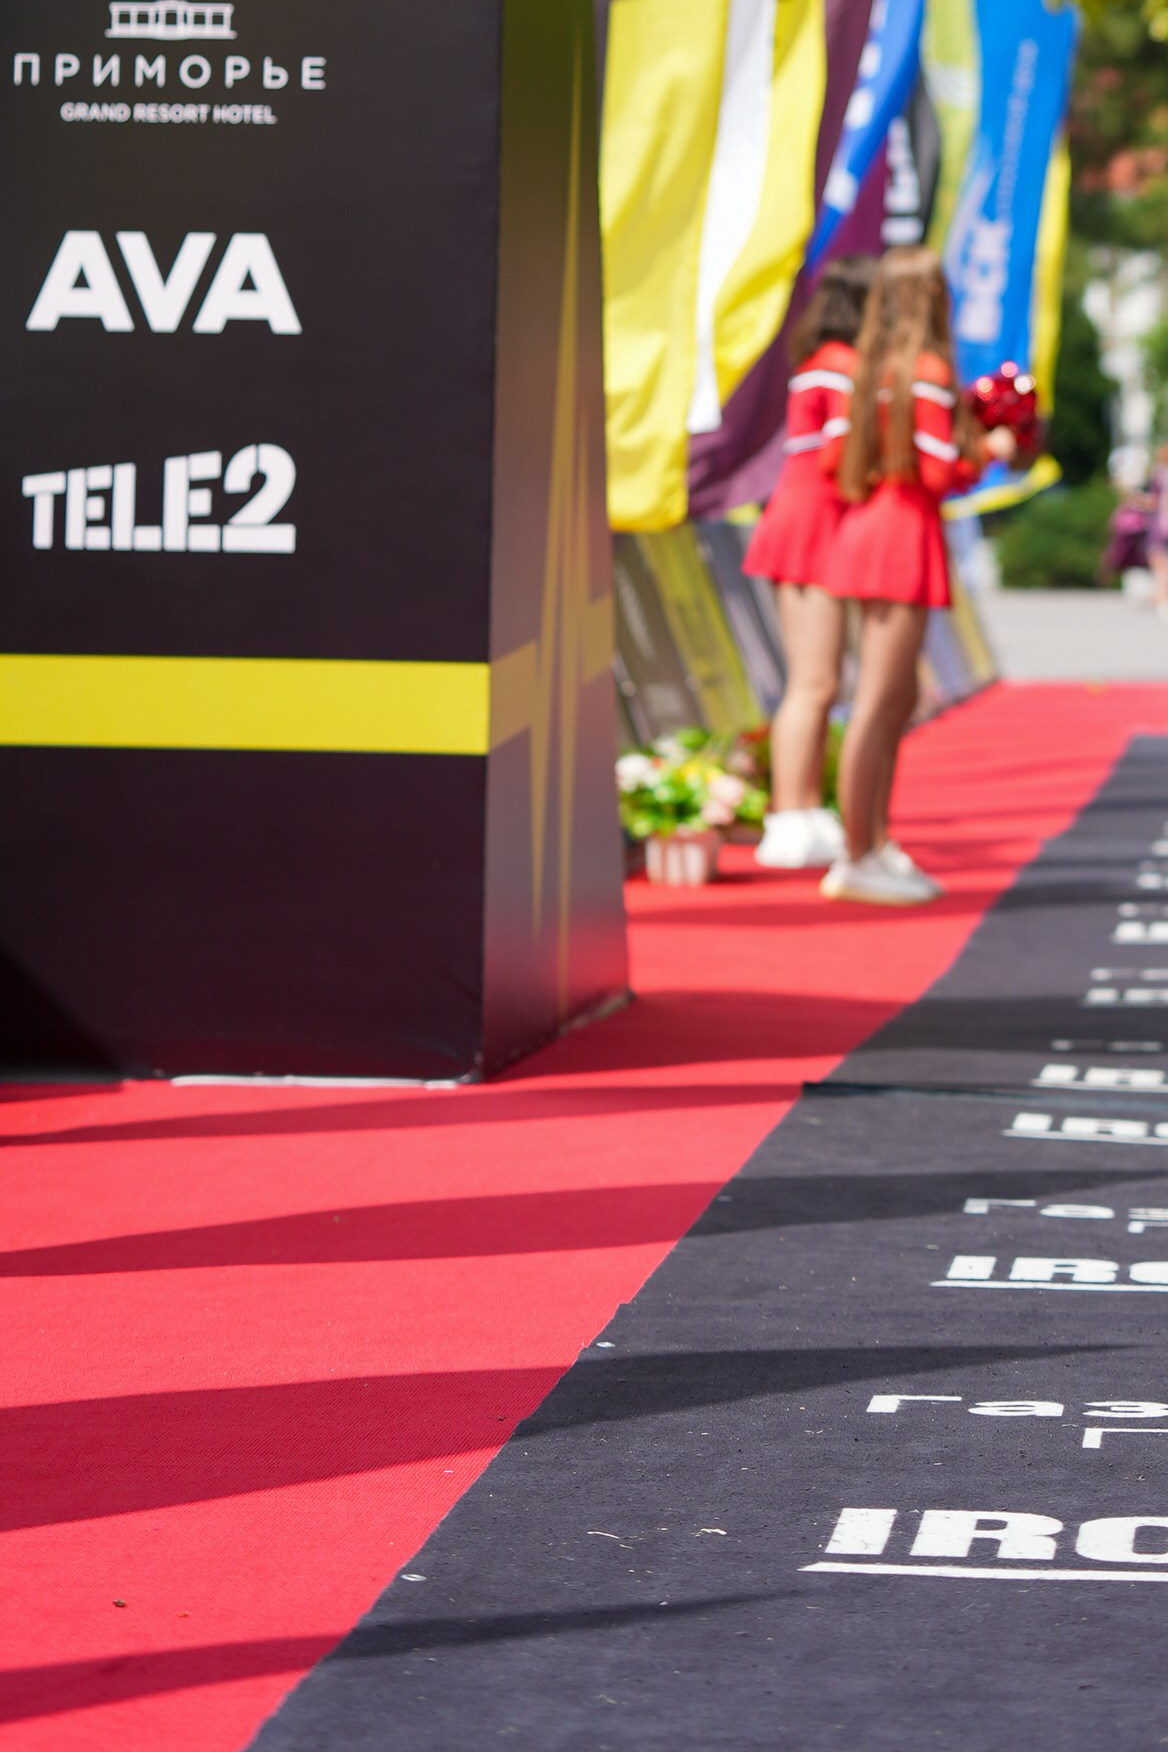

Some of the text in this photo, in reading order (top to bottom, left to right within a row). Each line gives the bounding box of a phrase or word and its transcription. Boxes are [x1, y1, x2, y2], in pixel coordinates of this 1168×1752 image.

[13, 52, 327, 90] ПРИМОРЬЕ
[60, 102, 278, 125] GRAND RESORT HOTEL
[26, 230, 302, 335] AVA
[22, 443, 296, 553] TELE2
